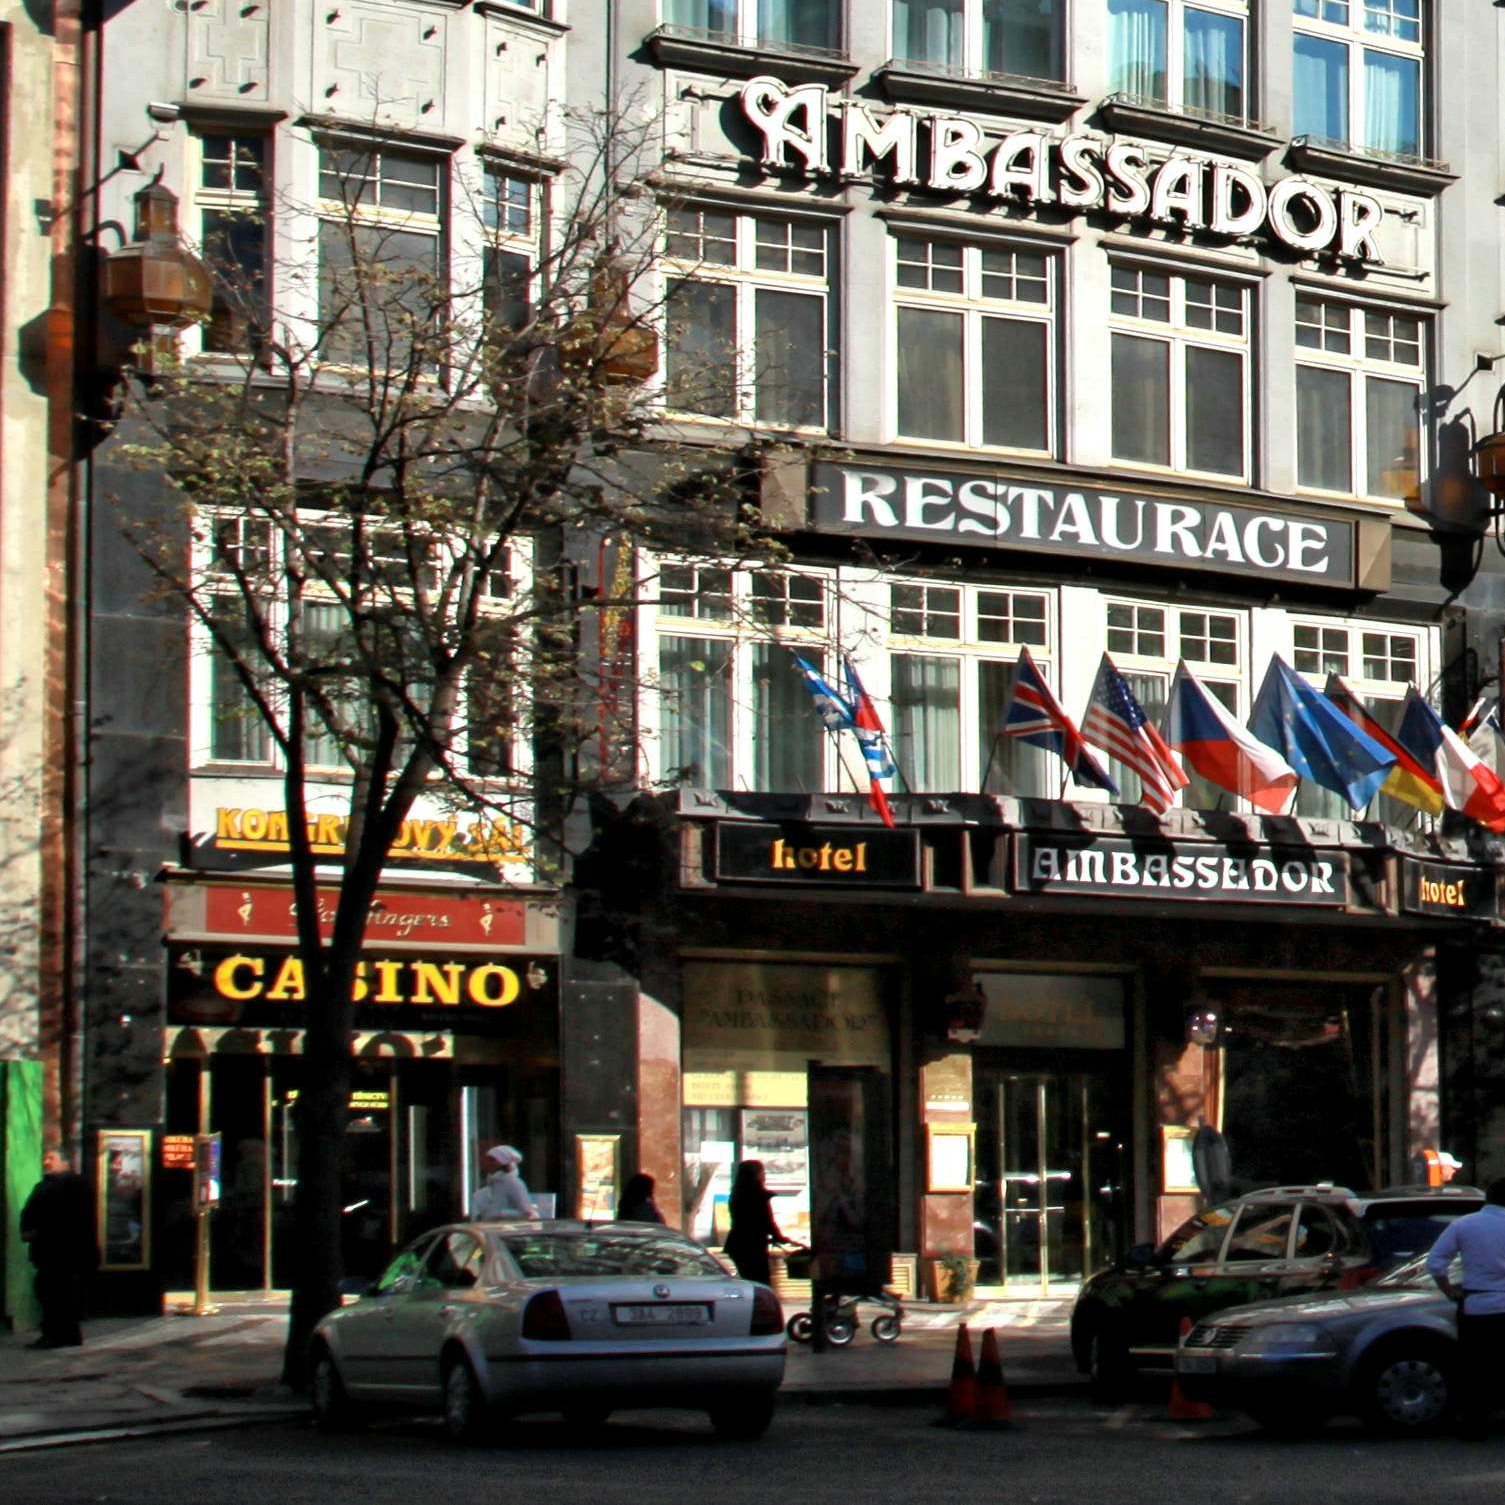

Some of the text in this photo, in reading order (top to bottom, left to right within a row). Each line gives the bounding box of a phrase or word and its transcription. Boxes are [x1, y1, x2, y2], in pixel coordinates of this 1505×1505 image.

[741, 77, 1384, 265] AMBASSADOR
[841, 470, 1330, 574] RESTAURACE
[216, 807, 457, 849] KONROVÝ
[771, 839, 867, 873] hotel
[1032, 846, 1335, 893] AMBASSADOR
[1419, 874, 1466, 906] hotel
